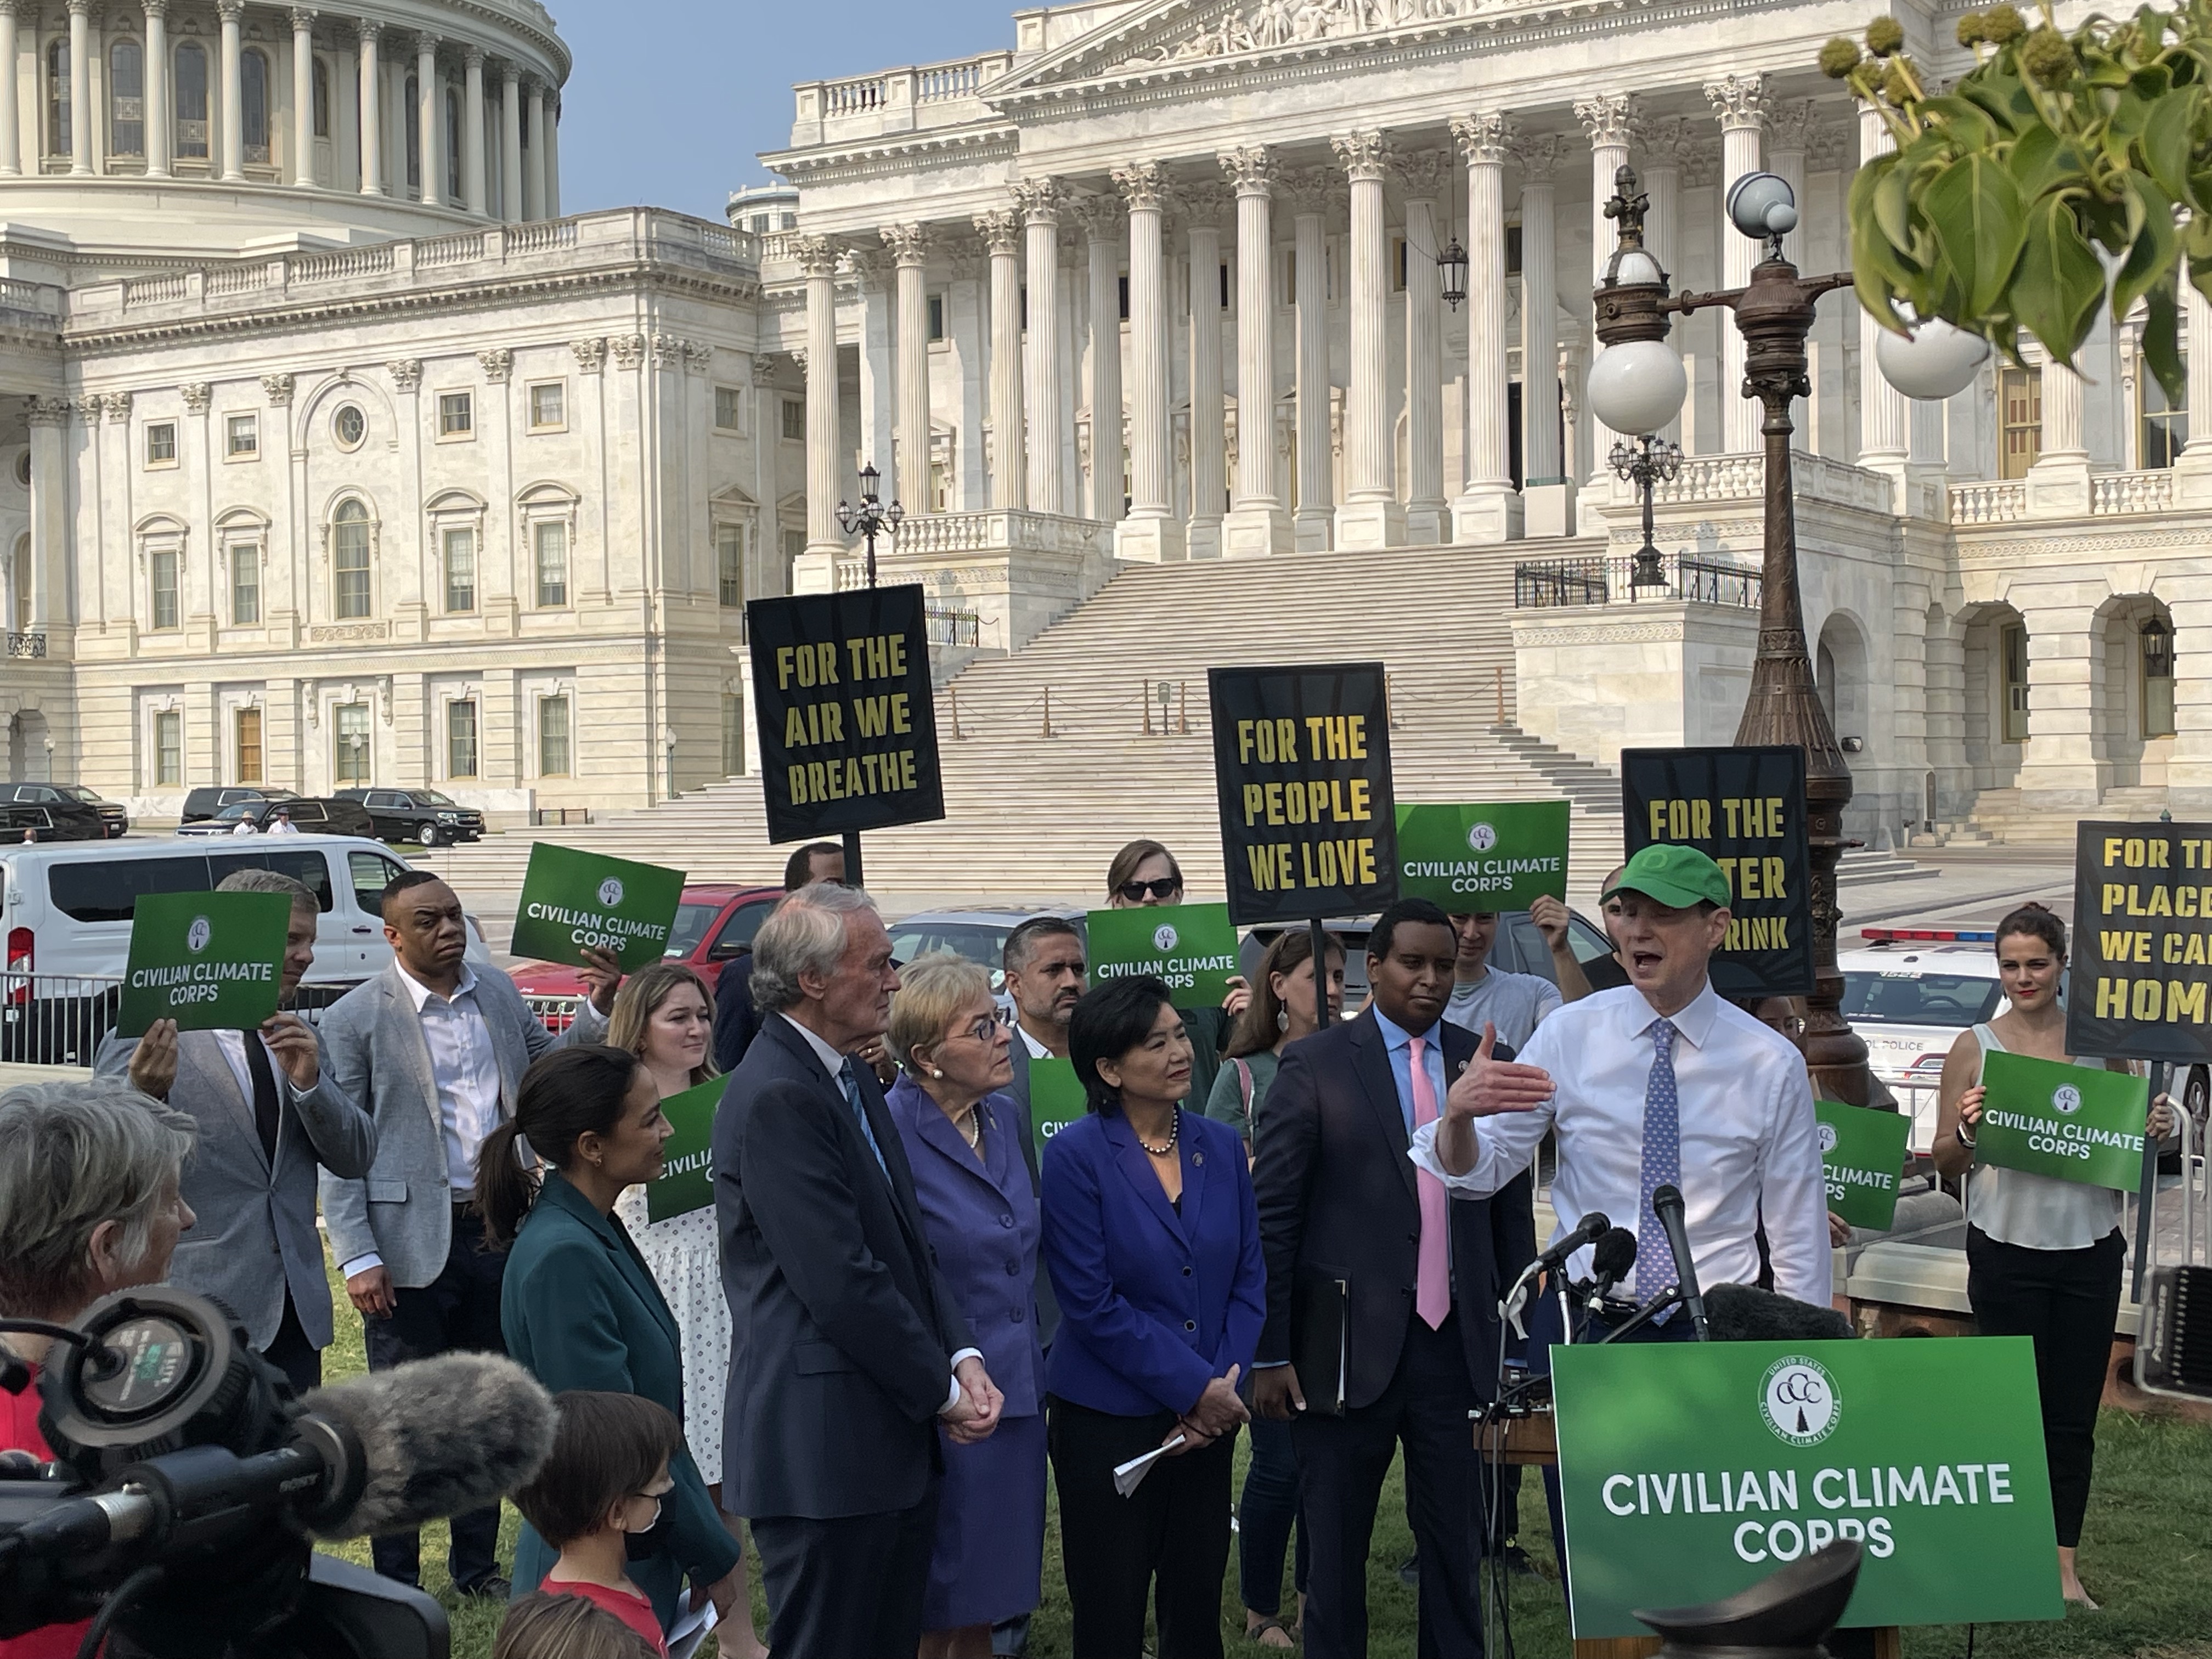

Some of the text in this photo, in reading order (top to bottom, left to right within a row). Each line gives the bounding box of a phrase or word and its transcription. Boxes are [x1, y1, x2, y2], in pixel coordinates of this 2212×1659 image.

[776, 634, 908, 690] FOR THE
[785, 693, 912, 749] AIR WE
[1238, 715, 1368, 764] FOR THE
[788, 750, 917, 806] BREATHE
[1243, 779, 1372, 826] PEOPLE
[1650, 798, 1784, 840] FOR THE
[1247, 838, 1377, 891] WE LOVE
[1403, 857, 1560, 877] CIVILIAN CLIMATE
[2103, 838, 2170, 868] FOR
[1452, 876, 1513, 893] CORPS
[1717, 857, 1787, 900] TER
[527, 902, 666, 940] CIVILIAN CLIMATE
[1722, 917, 1789, 951] RINK
[571, 929, 627, 952] CORPS
[2100, 931, 2212, 965] WE CA
[132, 962, 273, 988] CIVILIAN CLIMATE
[1098, 955, 1234, 979] CIVILIAN CLIMATE
[1155, 974, 1194, 989] RPS
[170, 984, 219, 1006] CORPS
[2095, 977, 2212, 1024] HOM
[1882, 1040, 1923, 1051] POLICE
[1985, 1109, 2145, 1152] CIVILIAN CLIMATE
[2028, 1135, 2091, 1160] CORPS
[659, 1147, 713, 1180] CIVILI
[1822, 1164, 1893, 1190] CLIMATE
[1768, 1358, 1826, 1376] UNITED STATES
[1760, 1400, 1841, 1444] CIVILIAN CLIMATE CORPS
[1602, 1463, 2014, 1516] CIVILIAN CLIMATE
[1734, 1516, 1895, 1563] CORPS
